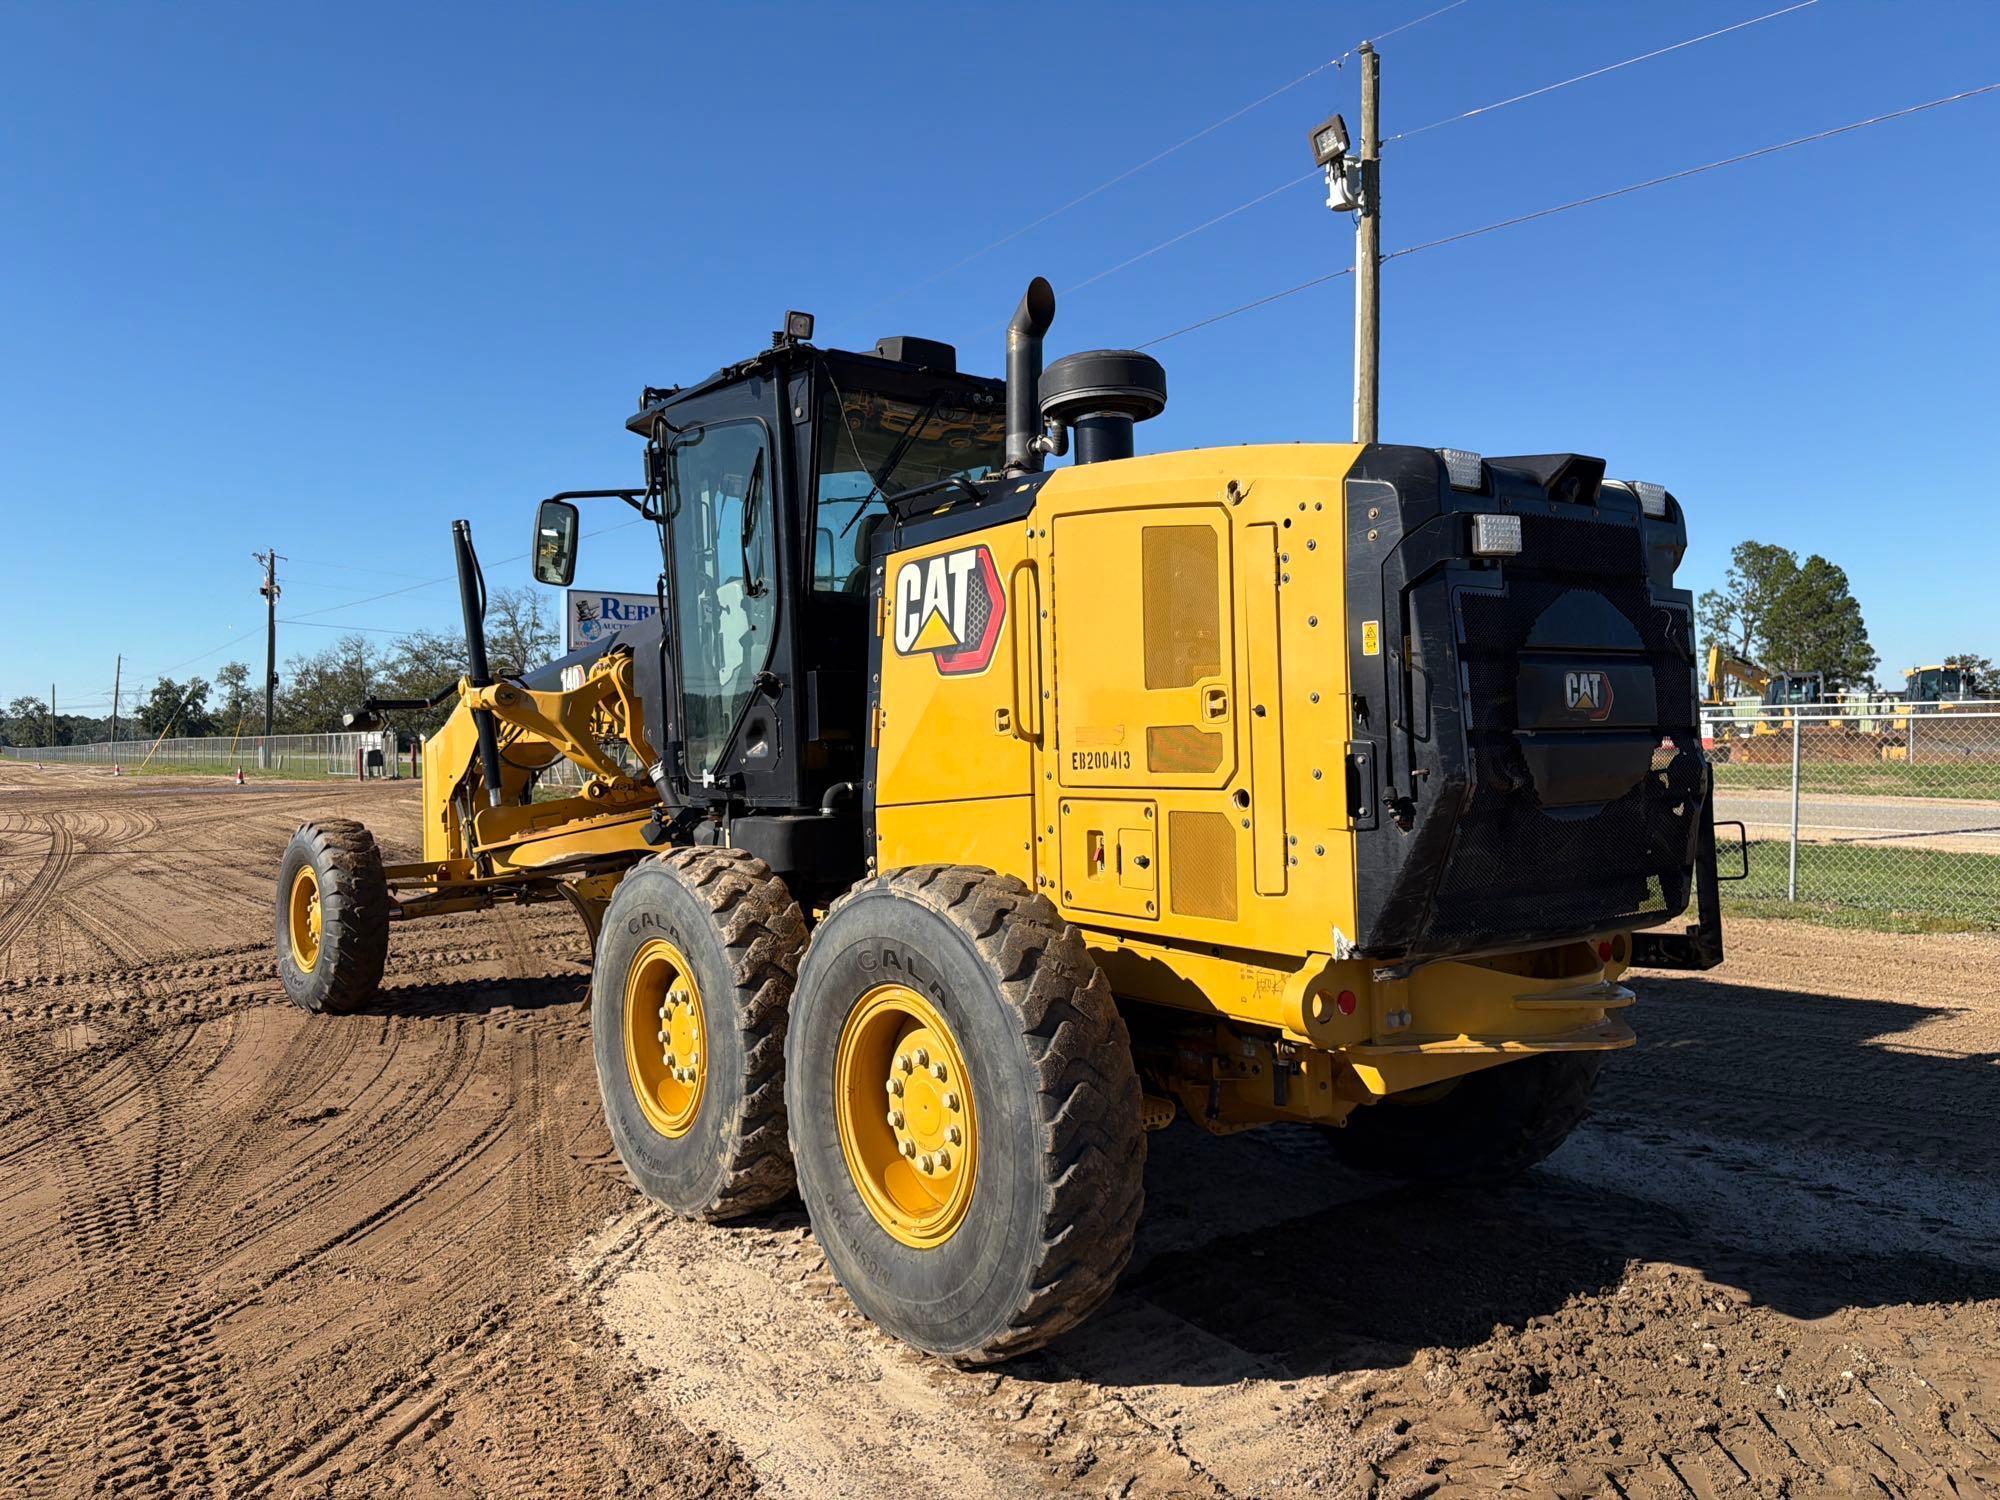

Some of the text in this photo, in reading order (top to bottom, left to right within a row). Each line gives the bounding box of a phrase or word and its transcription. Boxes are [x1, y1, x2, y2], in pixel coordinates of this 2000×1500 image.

[600, 597, 662, 621] REB
[895, 549, 976, 652] CAT
[1565, 672, 1602, 709] CAT
[1072, 750, 1131, 770] EB200413
